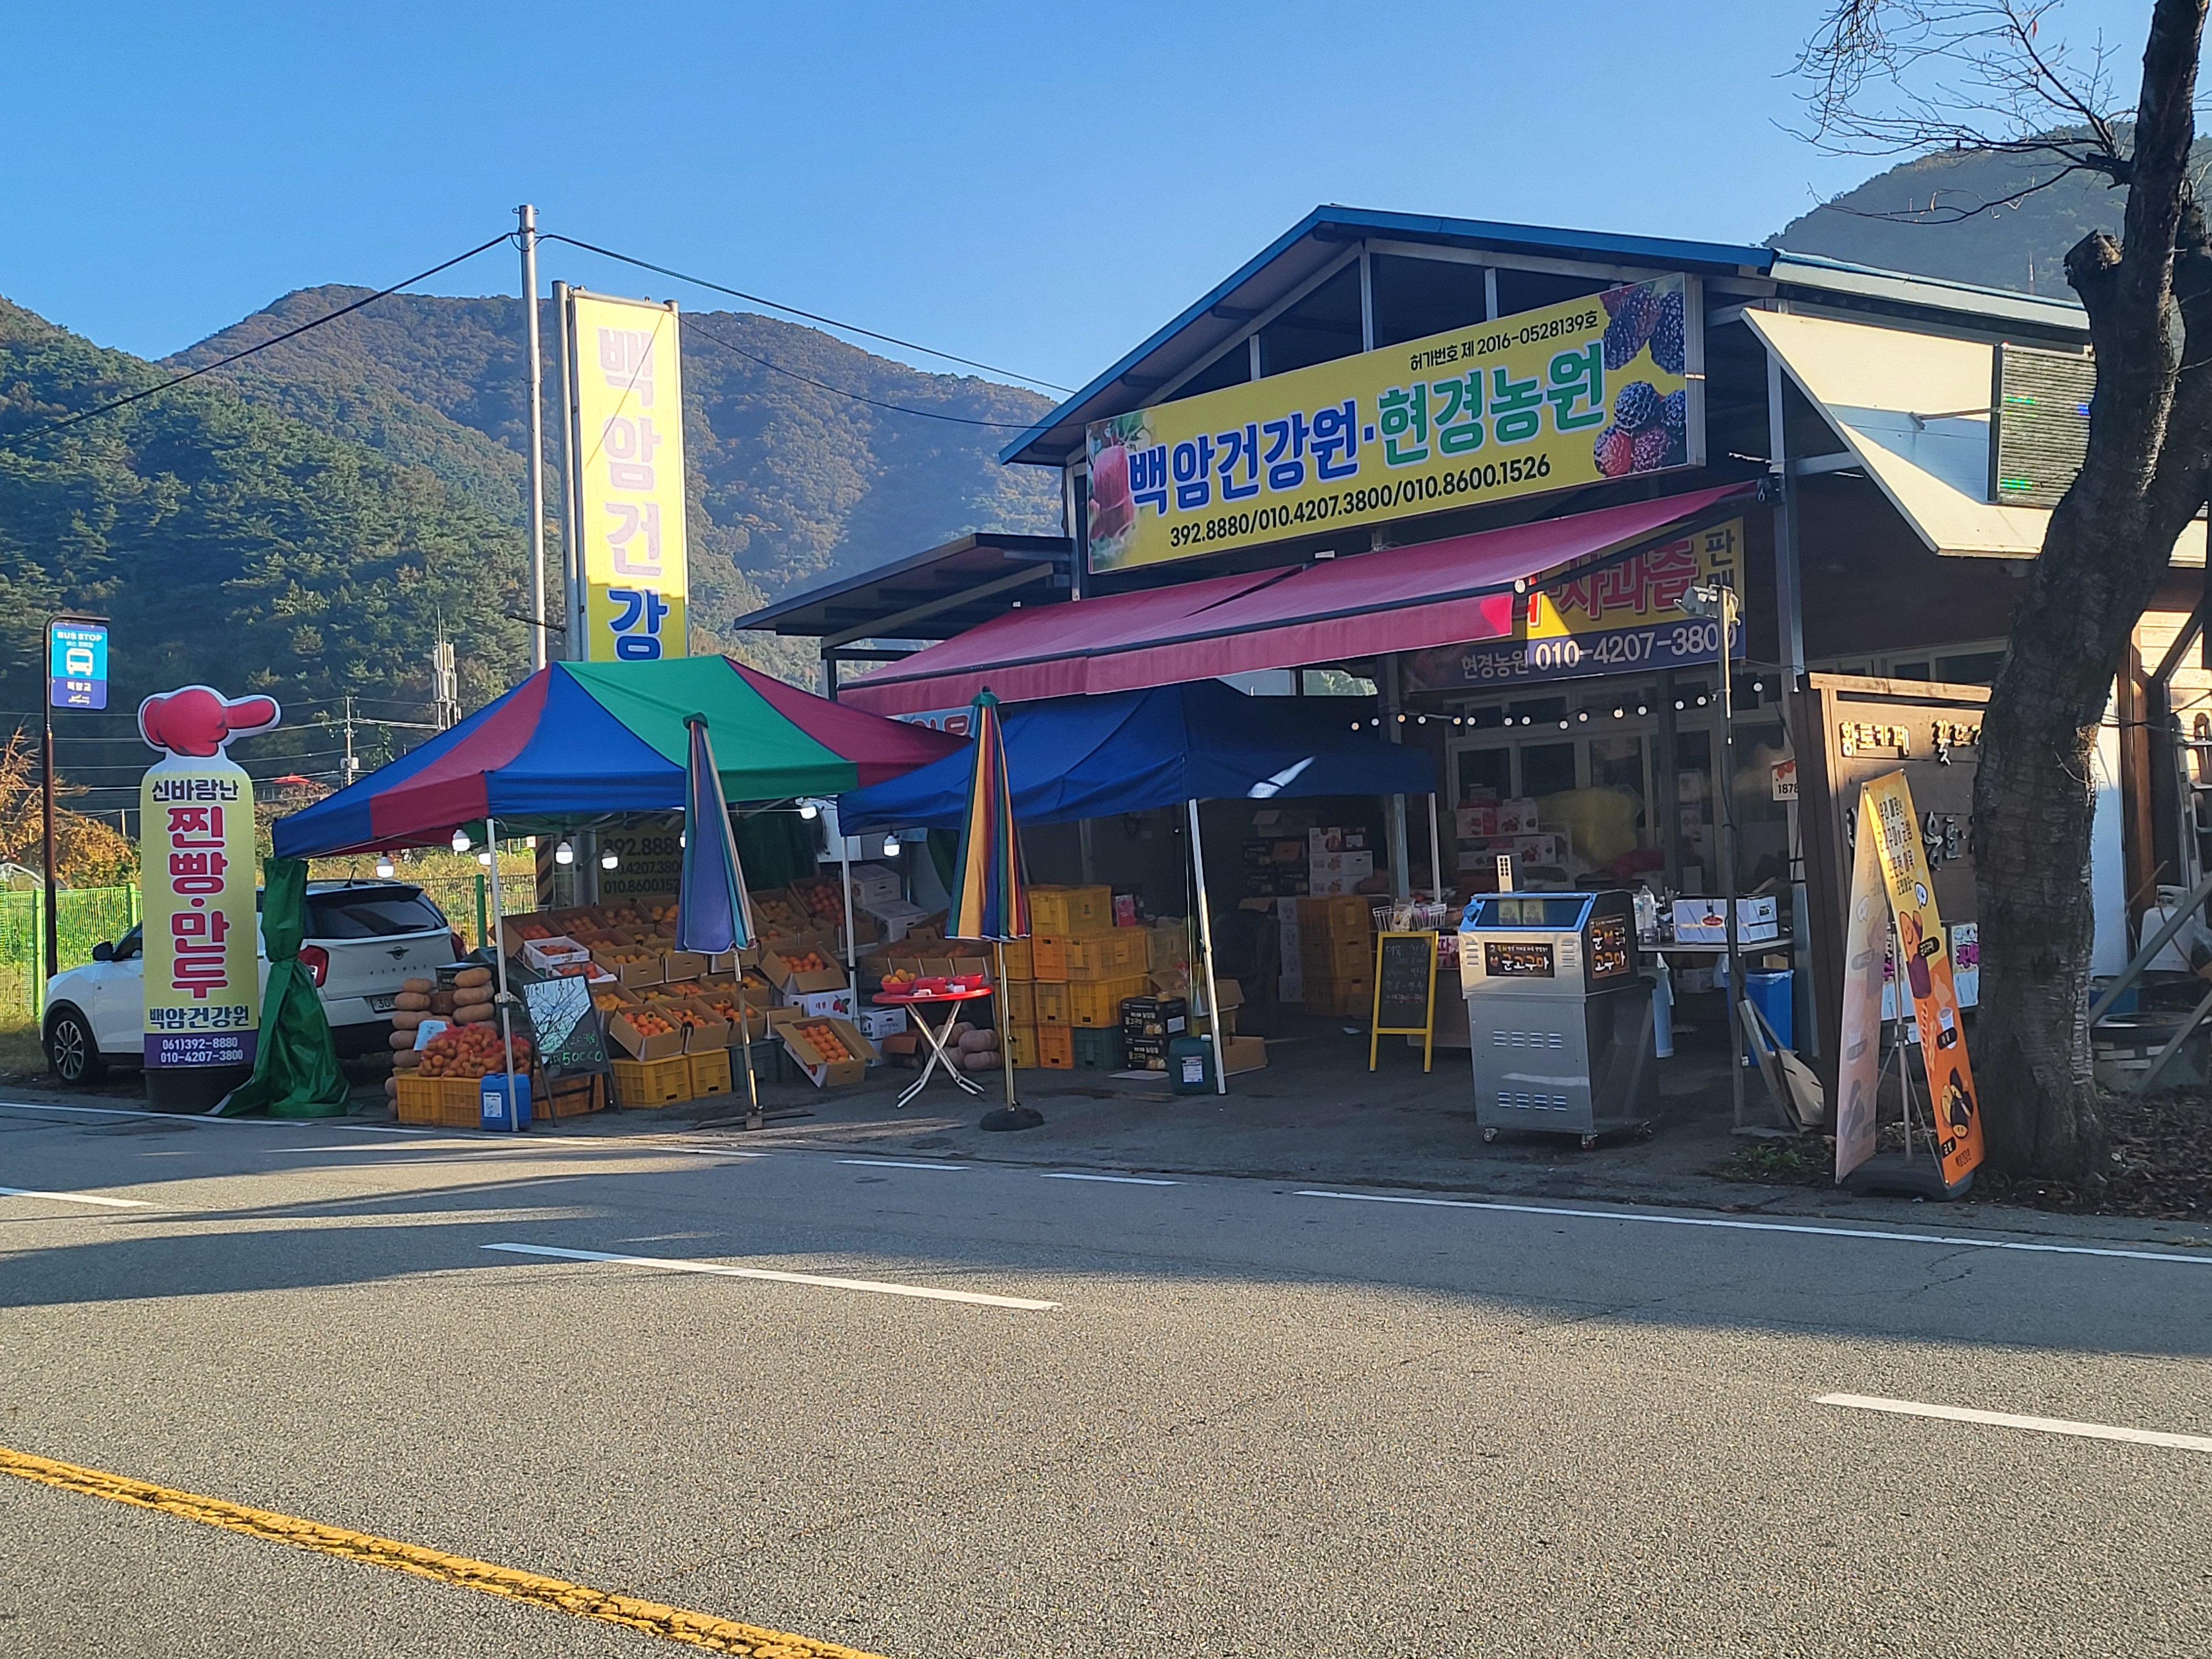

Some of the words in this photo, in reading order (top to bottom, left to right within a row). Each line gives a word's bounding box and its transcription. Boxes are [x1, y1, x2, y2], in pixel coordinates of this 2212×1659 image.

[1410, 343, 1459, 372] 허가번호
[1460, 340, 1475, 359] 제
[1477, 310, 1599, 356] 2016-0528139호
[1169, 453, 1551, 547] 392.8880/010.4207.3800/010.8600.1526
[57, 632, 77, 640] BUS
[78, 633, 103, 642] STOP
[1460, 650, 1529, 680] 현경농원
[151, 778, 239, 802] 신바람난
[1501, 953, 1550, 971] 군고구마
[1595, 950, 1626, 971] 고구마
[149, 1004, 249, 1029] 백암건강원
[162, 1036, 238, 1050] 061)392-8880
[160, 1049, 243, 1063] 010-4207-3800
